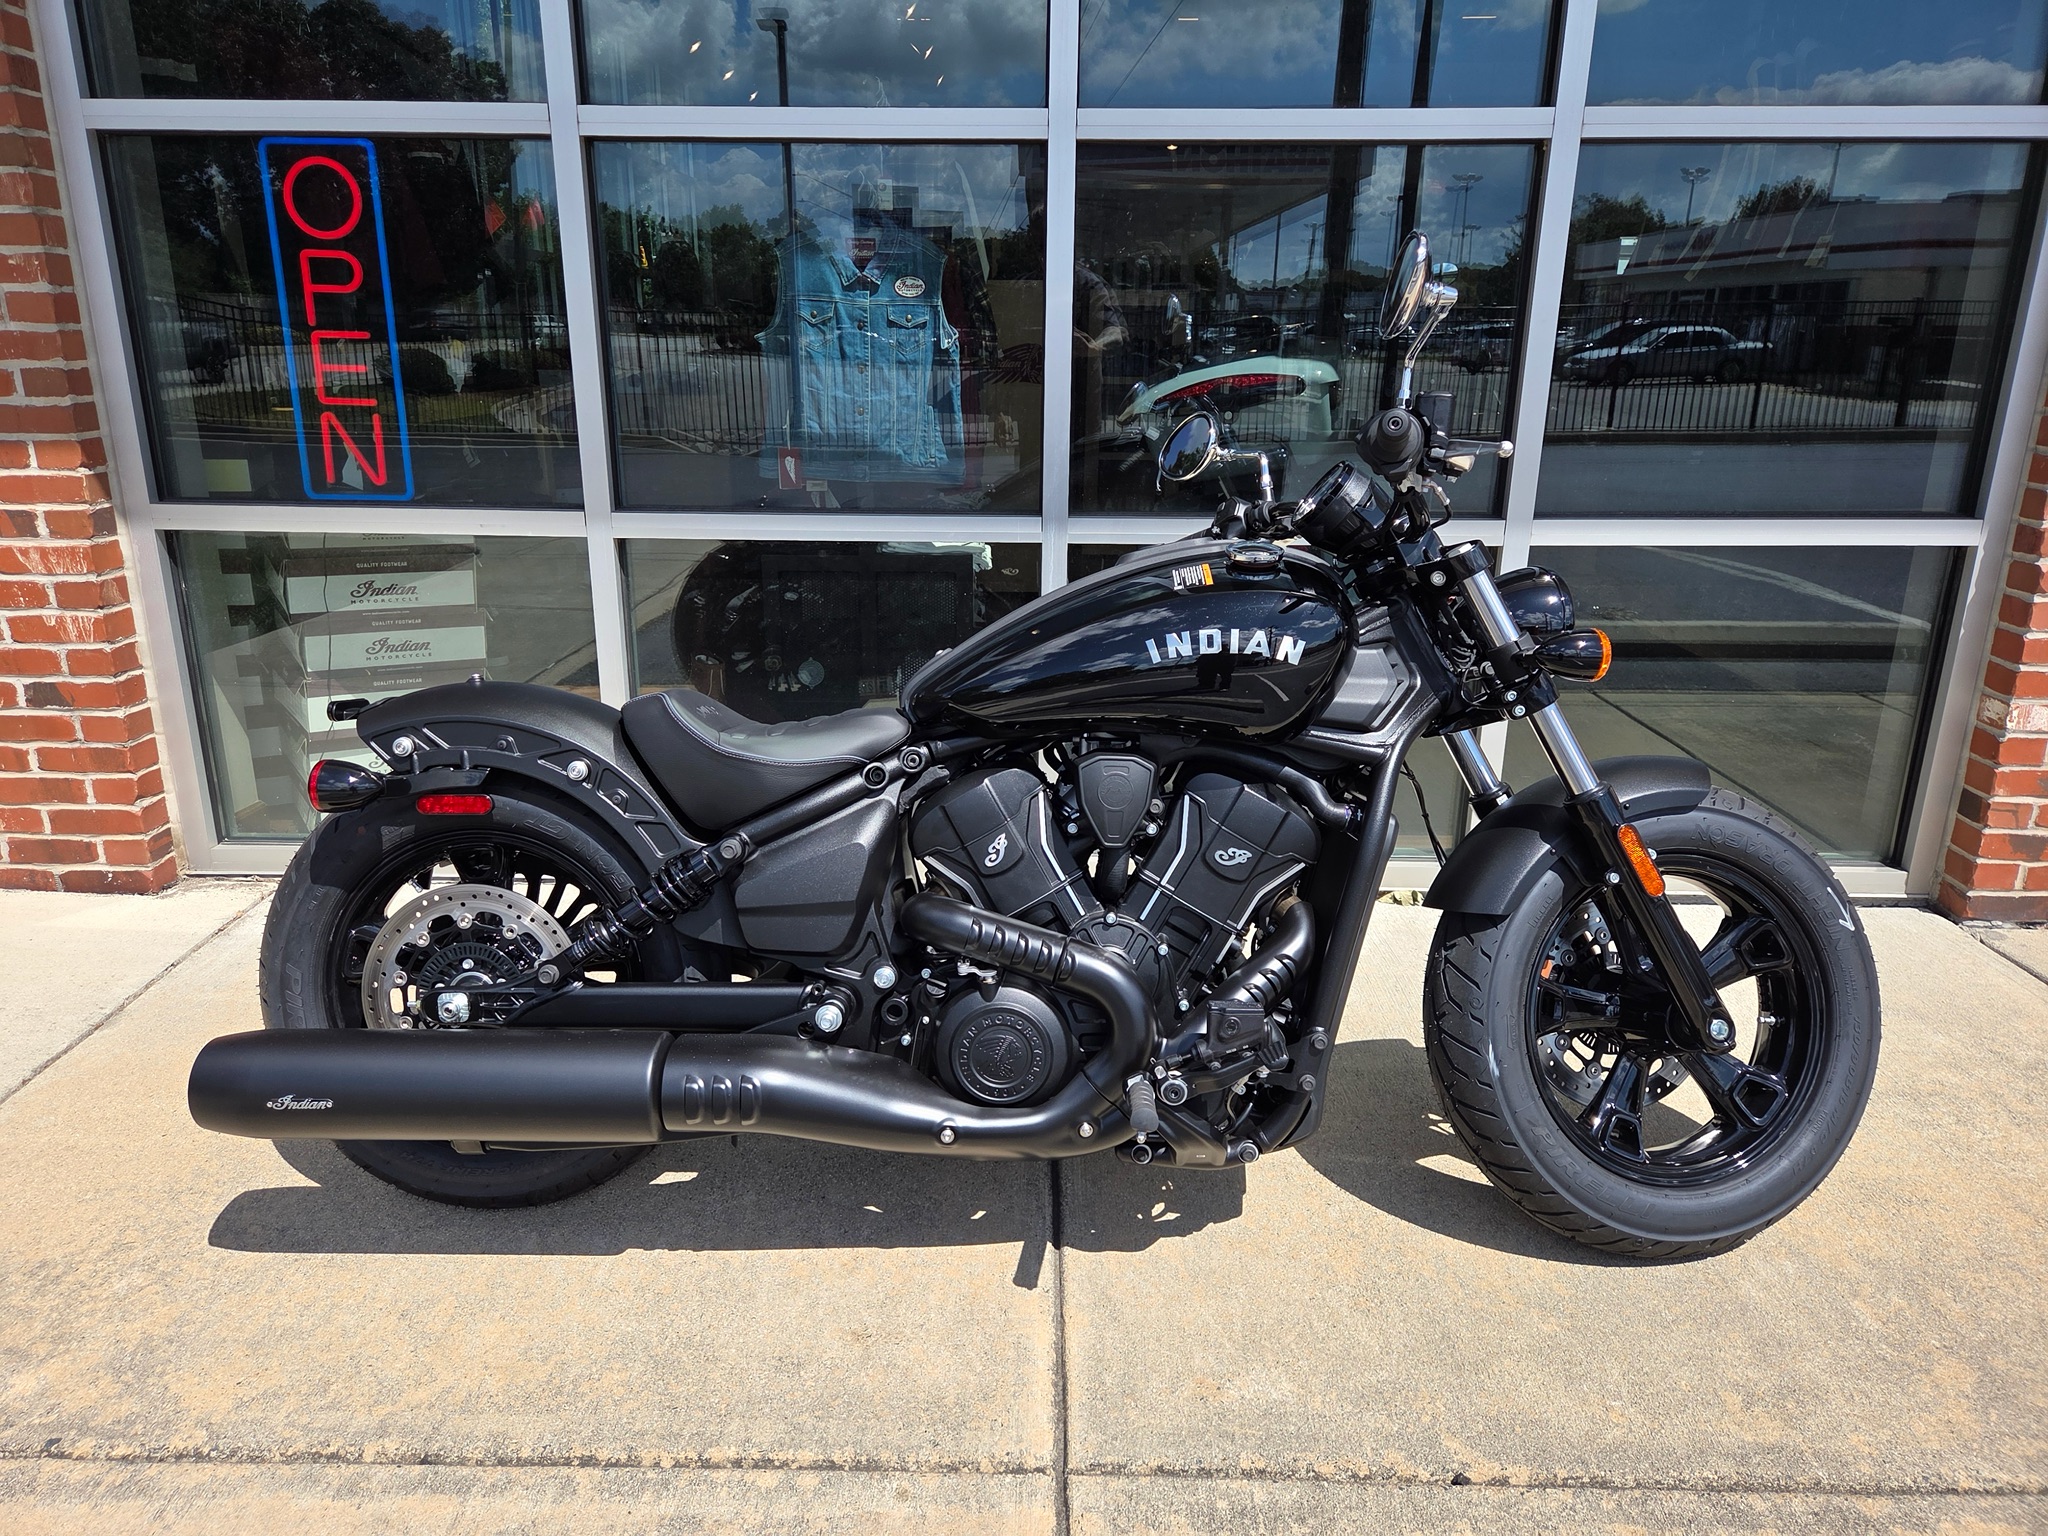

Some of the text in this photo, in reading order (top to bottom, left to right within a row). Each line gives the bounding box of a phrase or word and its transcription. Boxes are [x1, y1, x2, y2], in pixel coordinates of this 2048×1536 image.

[282, 154, 388, 487] OPEN
[380, 559, 408, 567] FOOTWEAR
[350, 580, 417, 598] Indian
[350, 596, 419, 604] MOTORCYCLE
[395, 617, 422, 625] FOOTWEAR
[365, 637, 431, 655] Indian
[1145, 628, 1307, 666] INDIAN
[365, 652, 433, 661] MOTORCYCLE
[373, 676, 423, 686] QUALITY FOOTWEAR
[1690, 822, 1851, 952] NIGHT DRAGON
[982, 1015, 1043, 1083] MOTORCYCLE
[272, 1093, 327, 1111] Indian
[1530, 1125, 1657, 1220] PIRELLI
